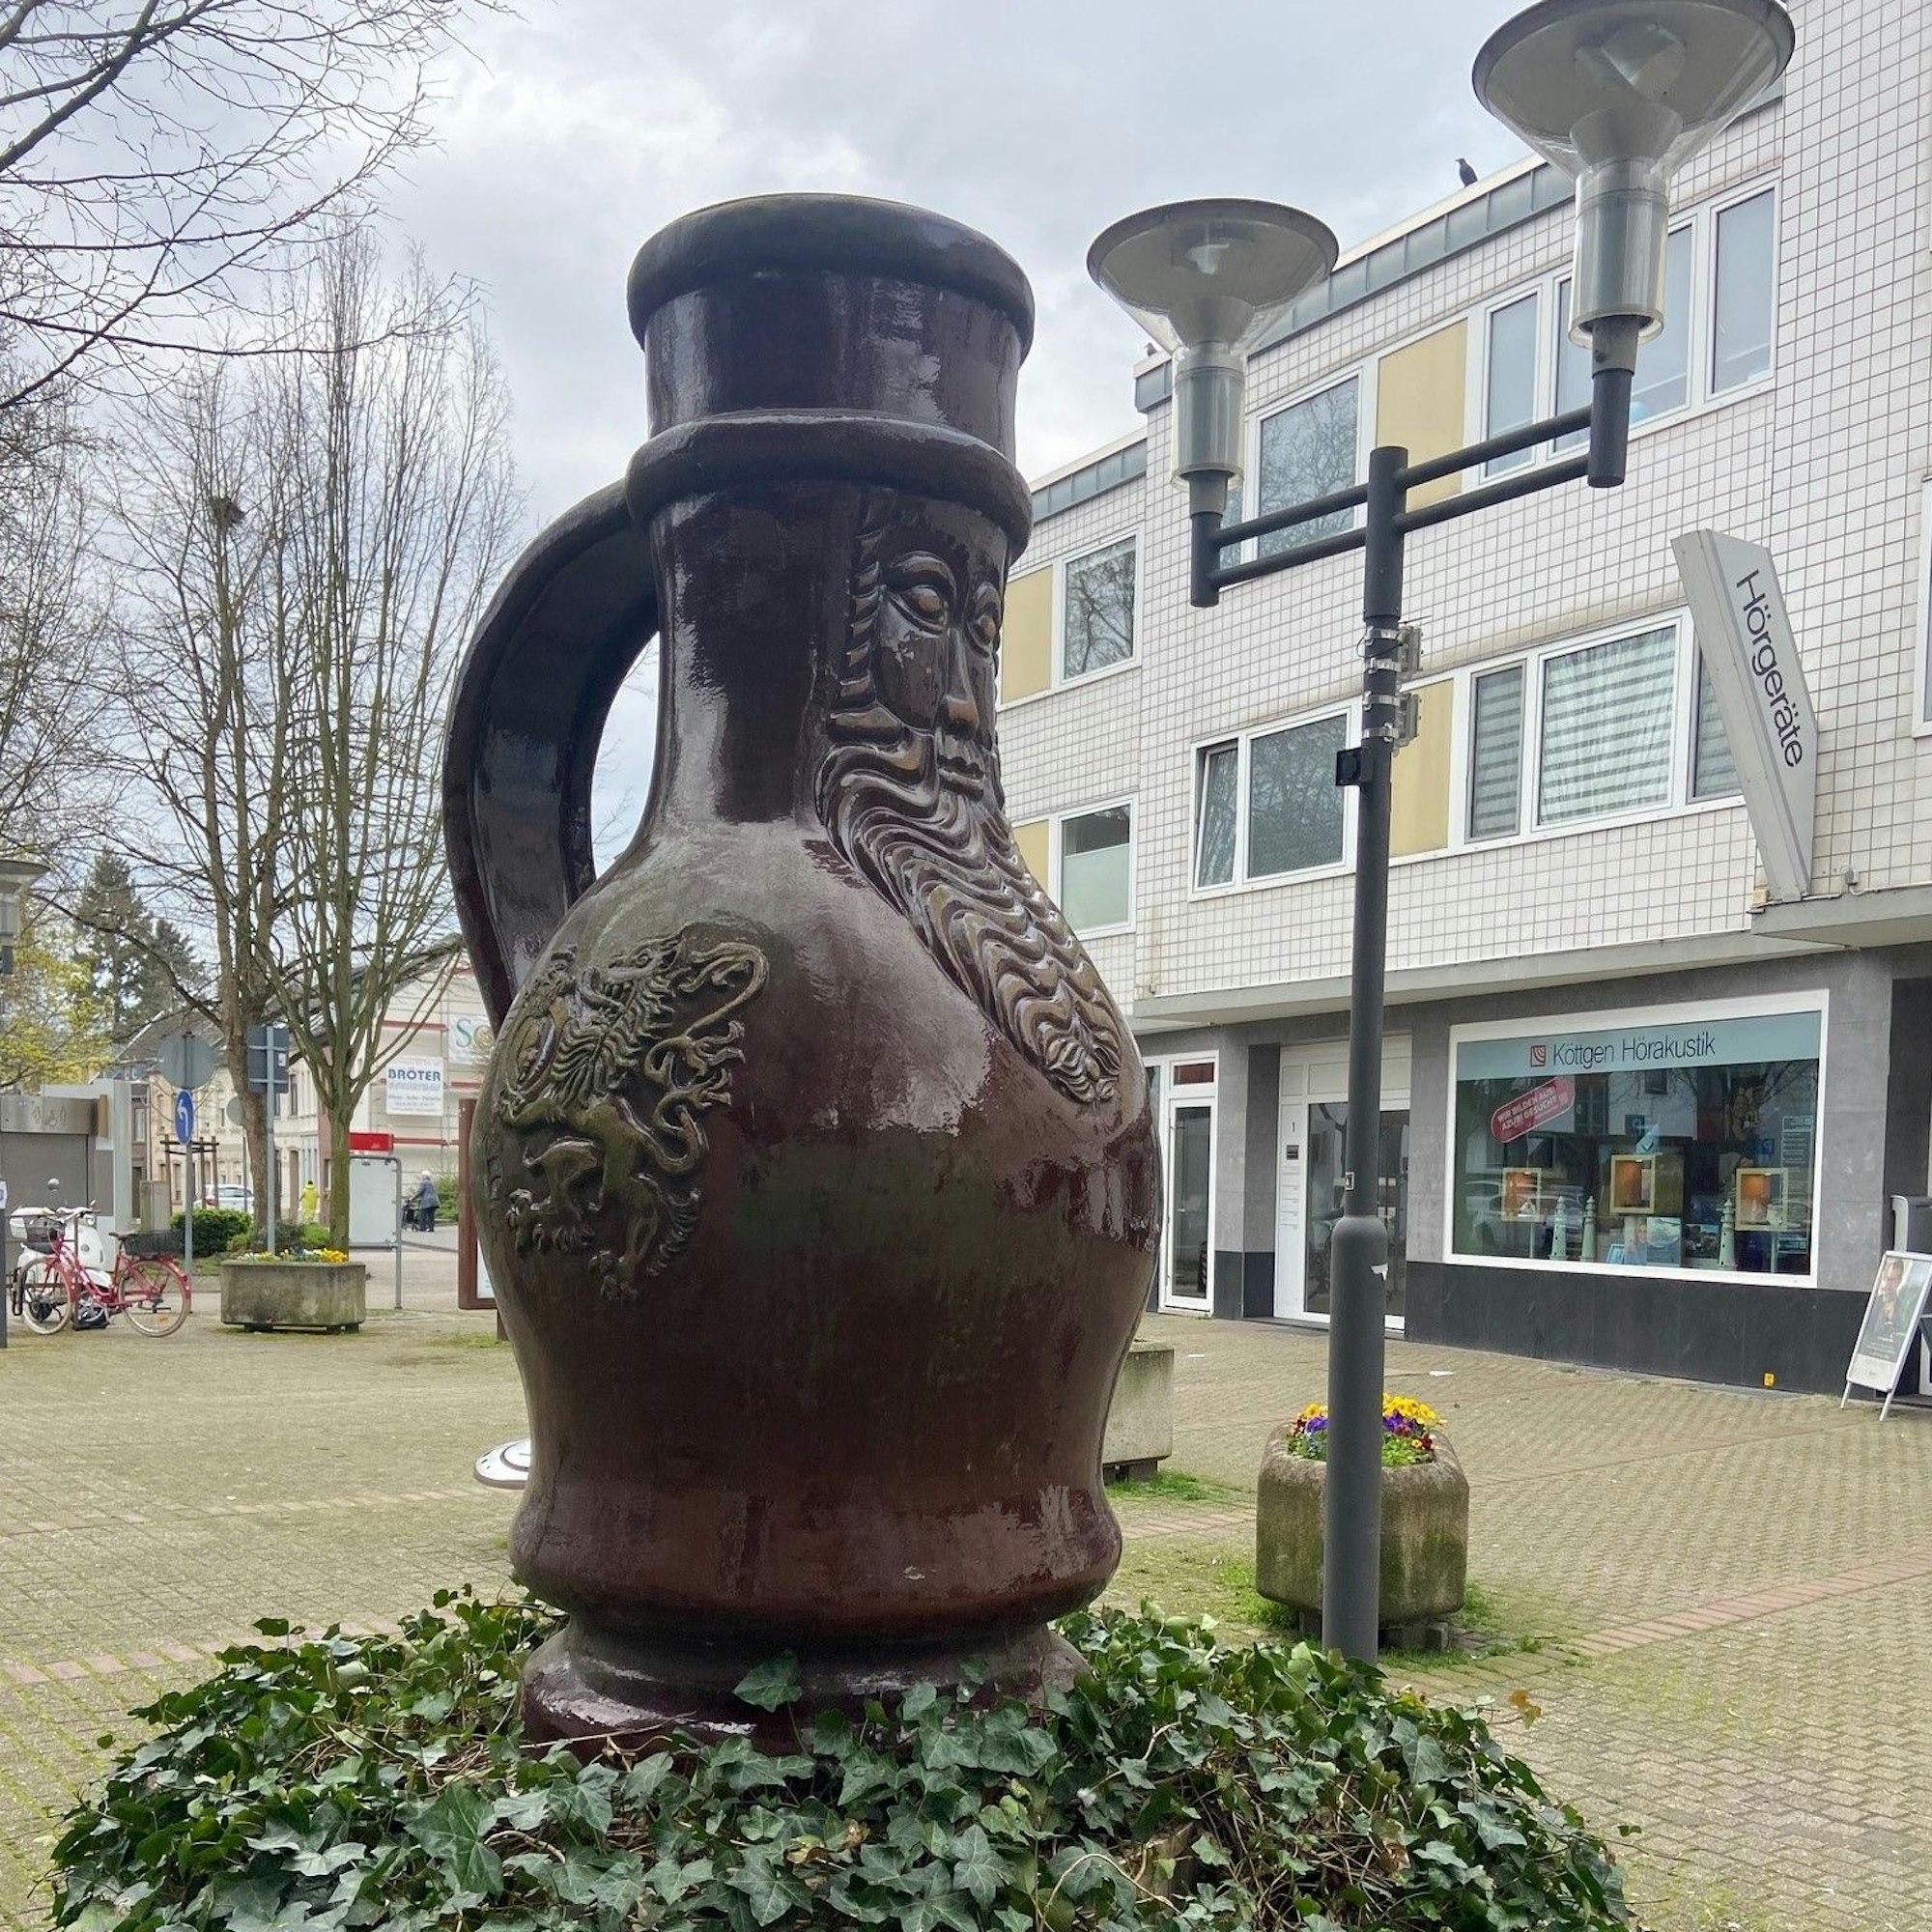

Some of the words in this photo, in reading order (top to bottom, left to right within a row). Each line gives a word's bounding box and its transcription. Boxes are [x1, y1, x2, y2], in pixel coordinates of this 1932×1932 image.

[1737, 569, 1804, 768] Hörgeräte
[1552, 1043, 1614, 1069] Köttgen
[1622, 1032, 1716, 1061] Hörakustik
[388, 1066, 441, 1081] BRÖTER
